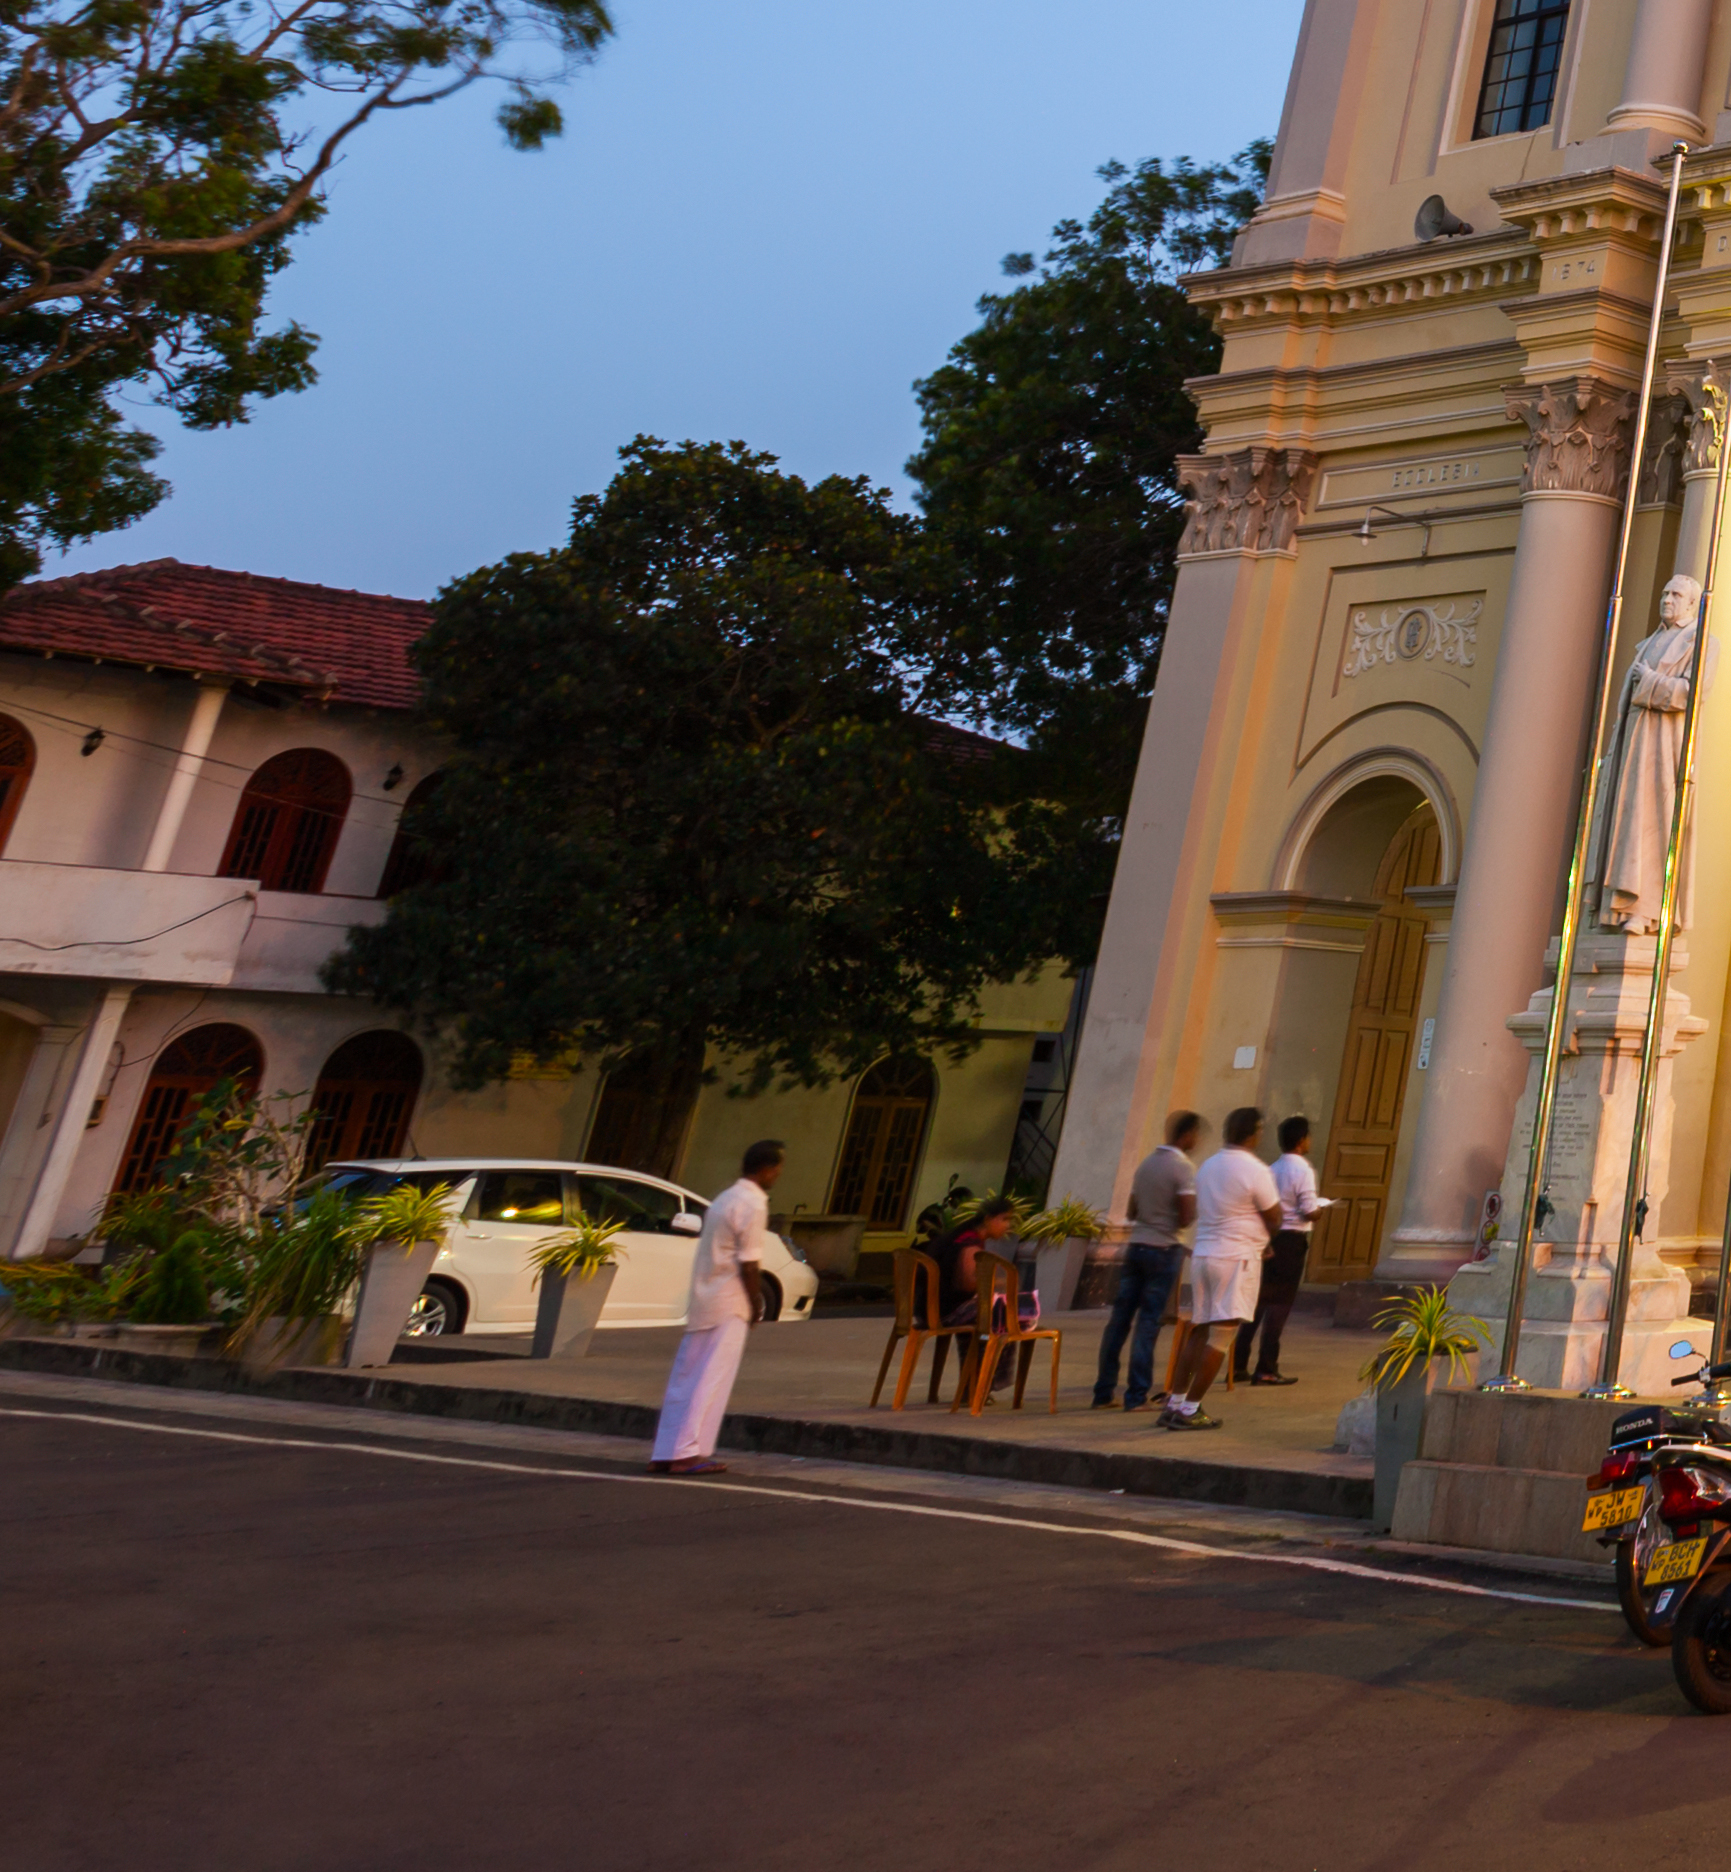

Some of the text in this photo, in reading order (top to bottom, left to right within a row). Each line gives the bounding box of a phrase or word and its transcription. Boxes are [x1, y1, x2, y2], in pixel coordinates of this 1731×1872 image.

[1551, 260, 1594, 280] 1874
[1615, 1417, 1654, 1435] HONDA
[1587, 1507, 1603, 1520] WP
[1601, 1505, 1632, 1526] 5810
[1660, 1560, 1692, 1580] 8561
